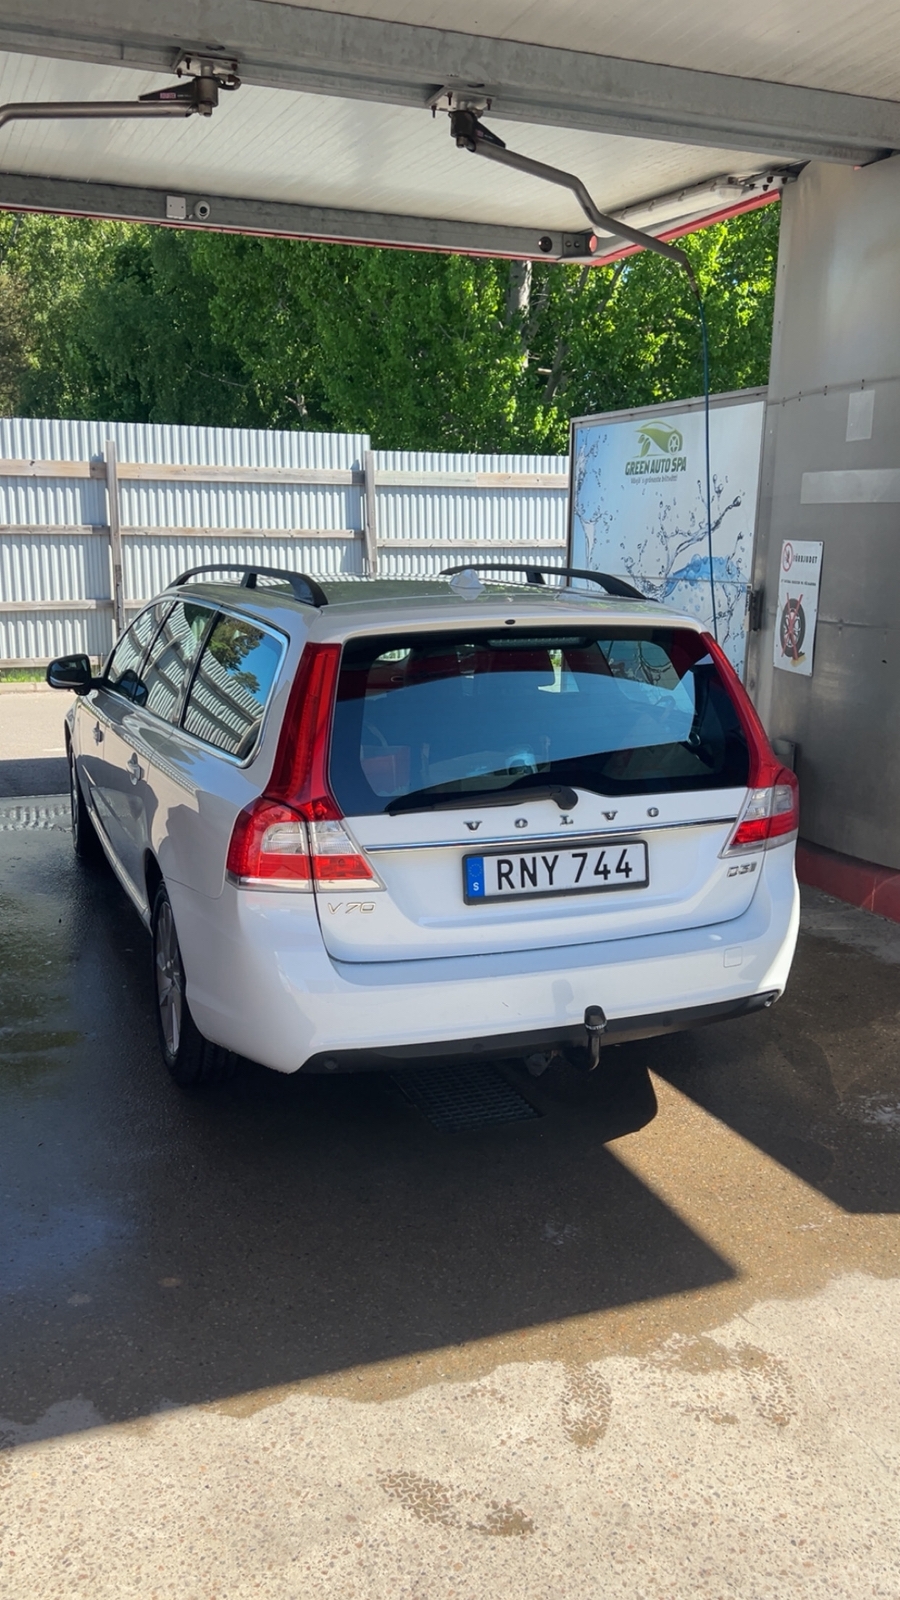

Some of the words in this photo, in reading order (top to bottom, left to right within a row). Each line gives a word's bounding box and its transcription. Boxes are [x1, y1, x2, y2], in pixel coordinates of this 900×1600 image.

[625, 460, 650, 475] GREEN
[650, 458, 671, 474] AUTO
[671, 456, 687, 472] SPA
[793, 554, 817, 563] FÖRBJUDET
[463, 807, 660, 831] VOLVO
[497, 855, 559, 890] RNY
[571, 849, 633, 883] 744
[472, 882, 480, 891] S
